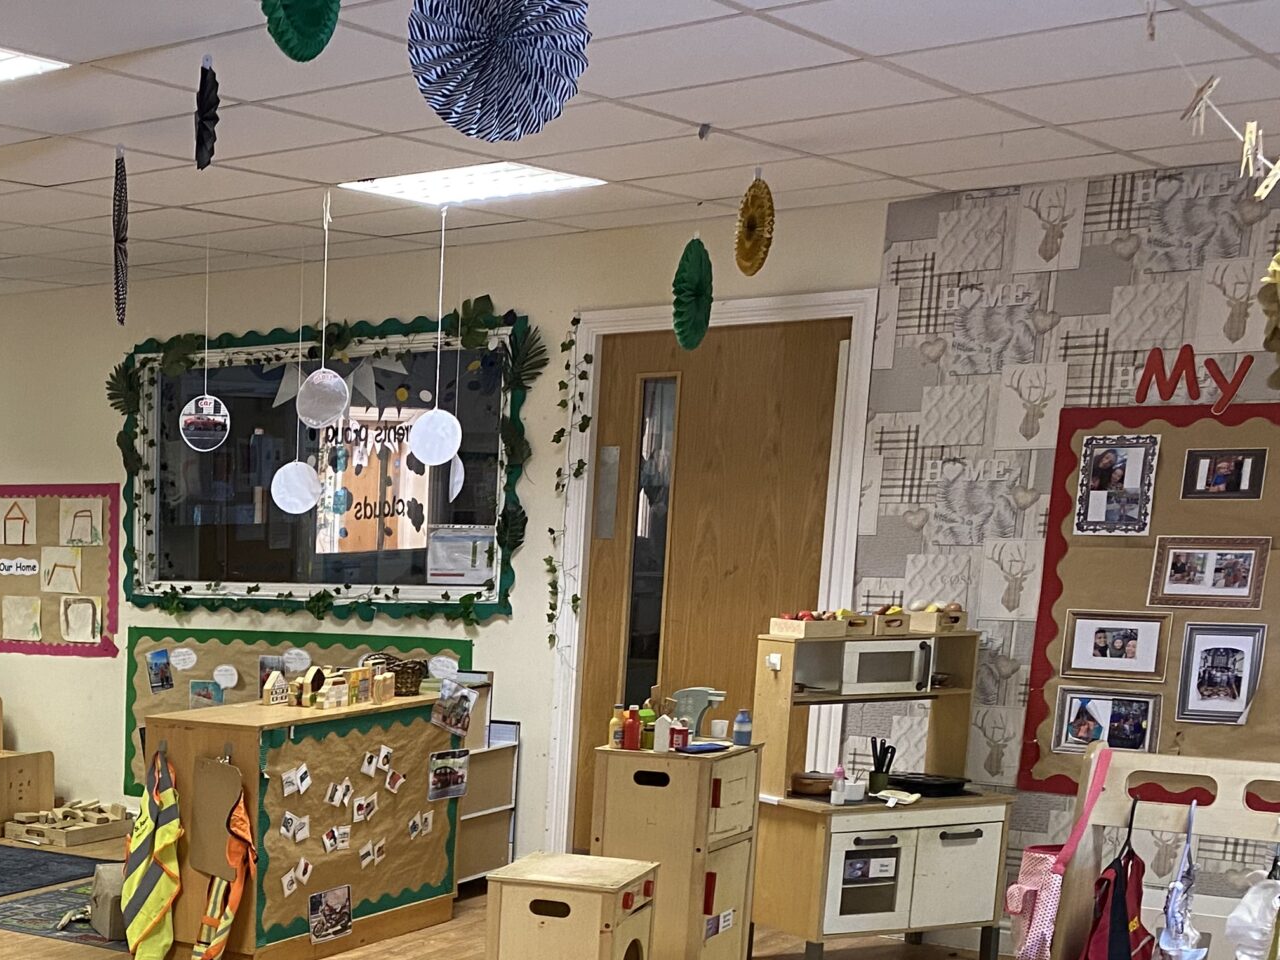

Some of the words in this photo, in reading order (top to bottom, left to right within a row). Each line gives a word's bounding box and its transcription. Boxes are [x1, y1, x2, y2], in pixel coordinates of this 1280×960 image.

[1135, 344, 1255, 415] My
[198, 400, 213, 408] car
[16, 562, 37, 572] Home
